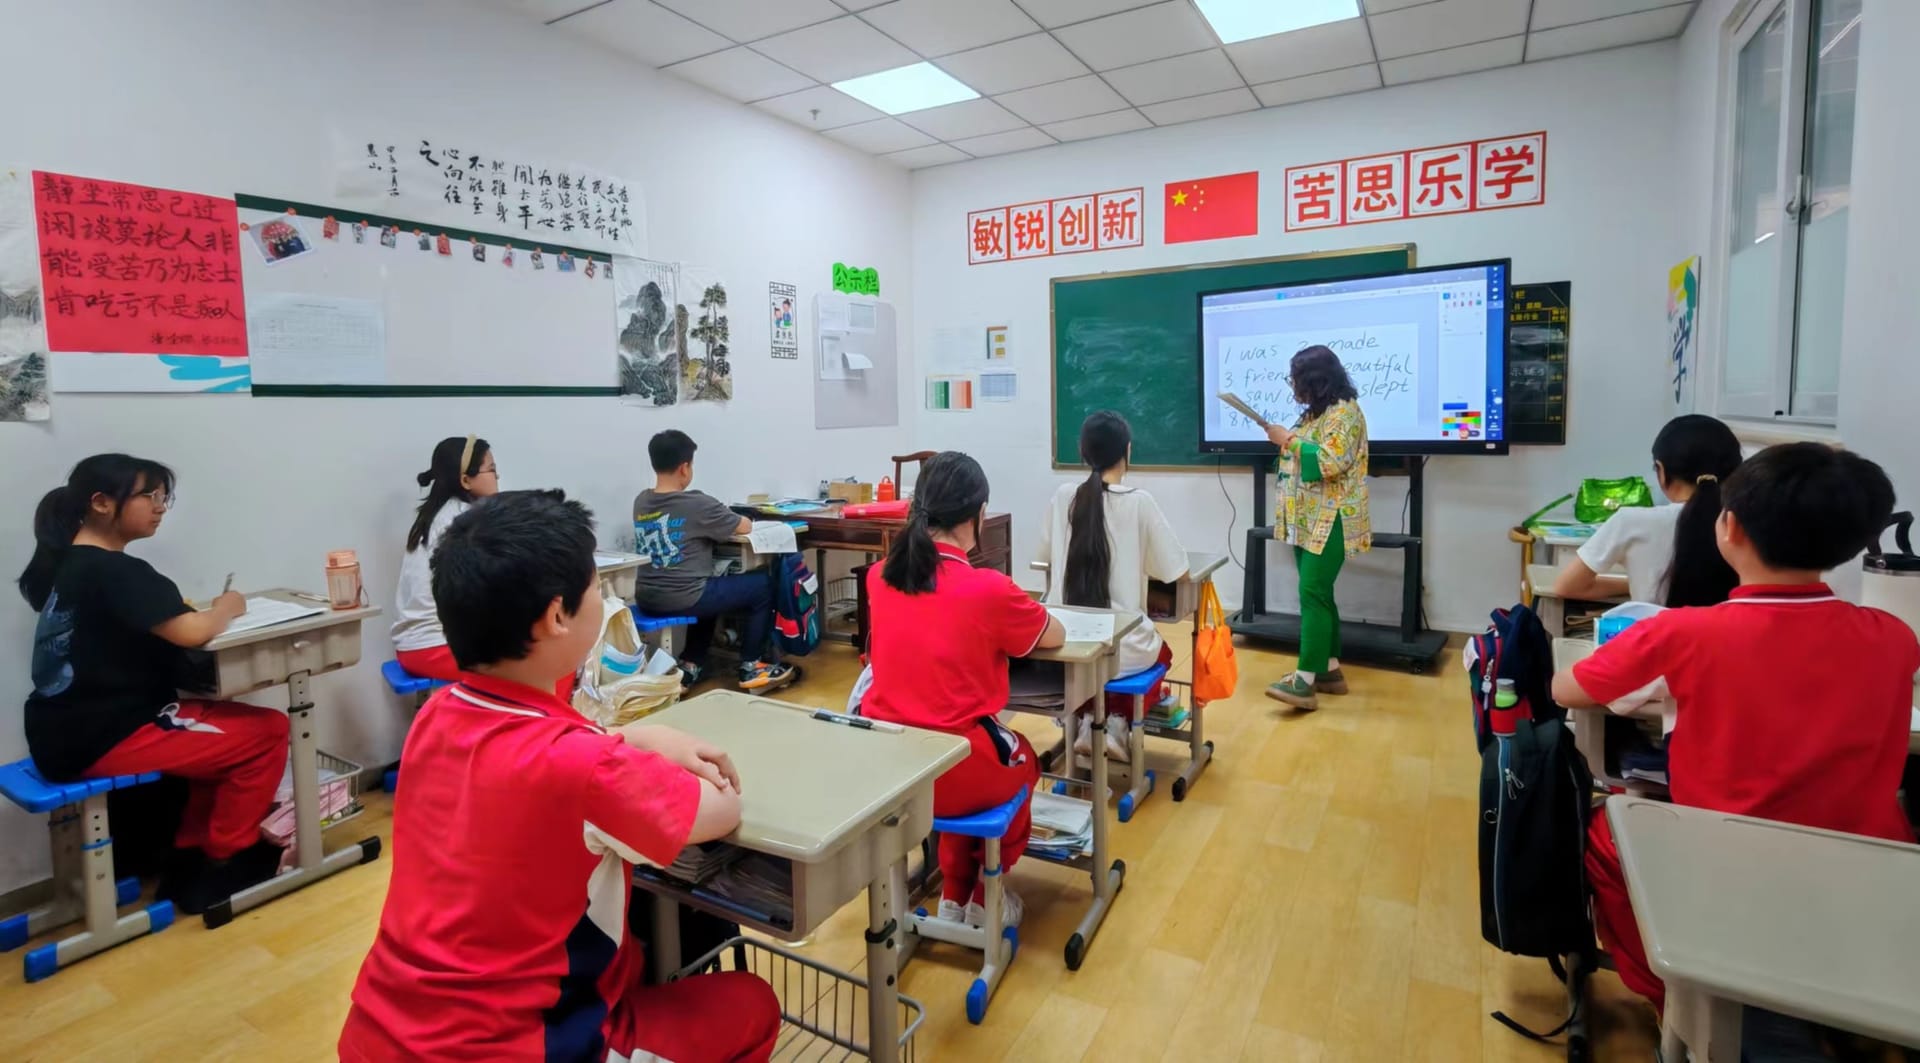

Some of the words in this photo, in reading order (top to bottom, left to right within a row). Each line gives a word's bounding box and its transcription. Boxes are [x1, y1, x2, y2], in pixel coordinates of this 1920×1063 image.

[419, 140, 440, 167] 之
[40, 173, 225, 223] 静坐常思己过
[1292, 145, 1536, 222] 苦思乐学
[42, 210, 234, 256] 闲谈莫论人非
[972, 197, 1138, 257] 敏锐创新
[835, 267, 879, 293] 公示栏
[49, 286, 245, 321] 肯吃亏不是痴人
[1240, 344, 1279, 361] was
[1327, 331, 1381, 351] made
[1224, 371, 1233, 388] 3
[1244, 368, 1288, 388] frien
[1343, 353, 1414, 382] eautiful
[1246, 388, 1283, 404] saw
[1358, 374, 1409, 401] slept
